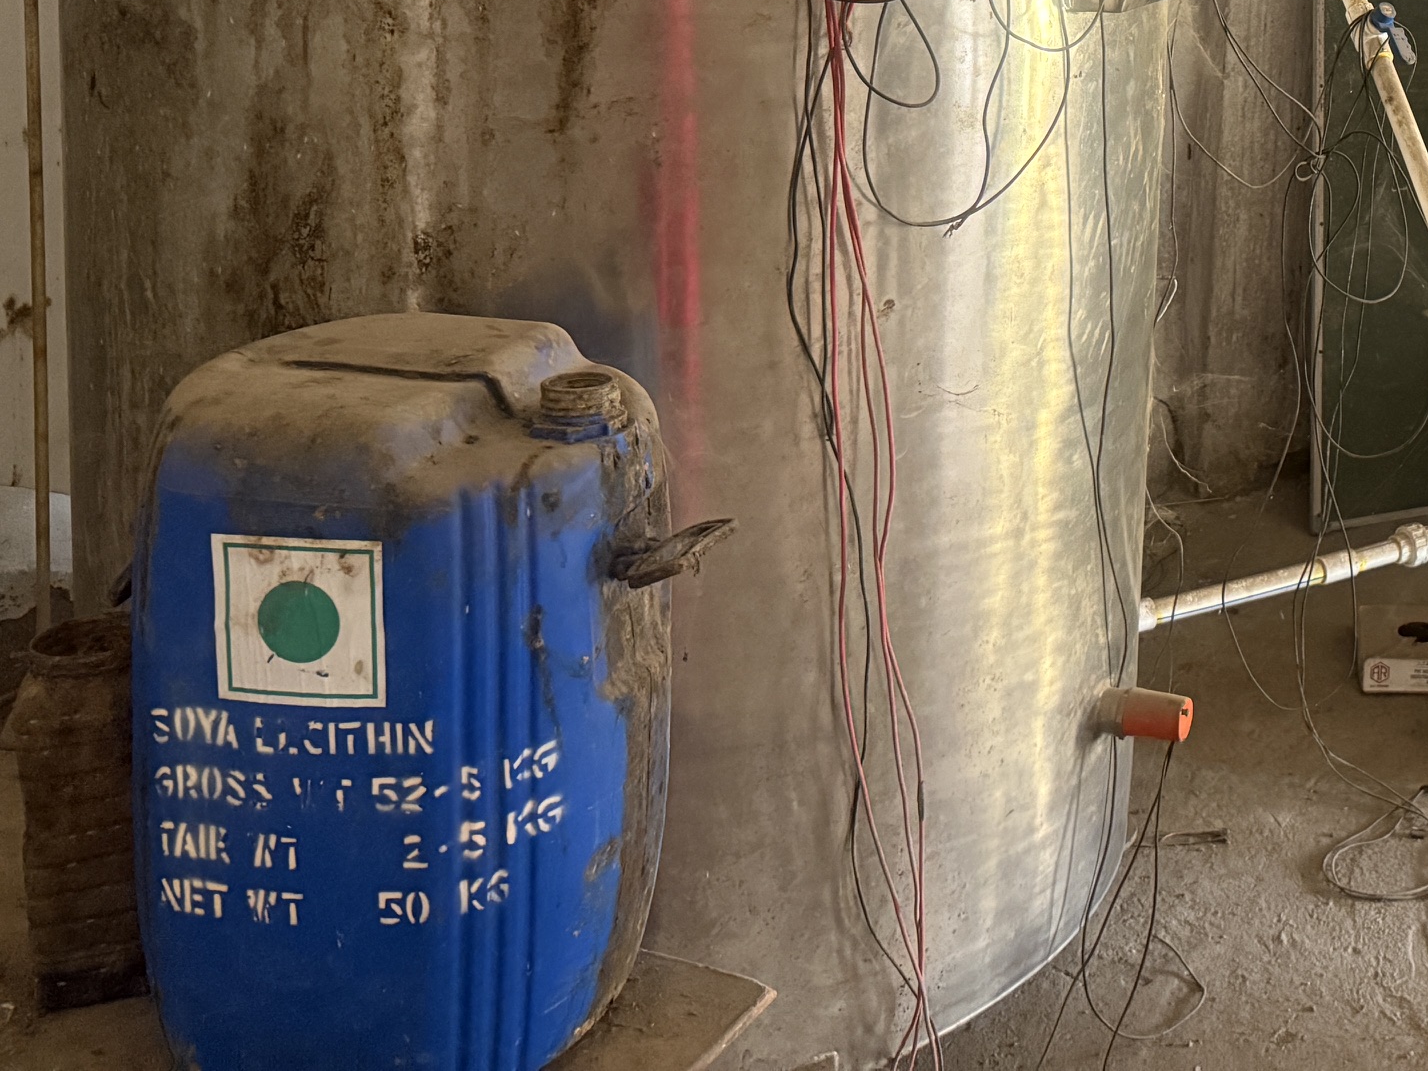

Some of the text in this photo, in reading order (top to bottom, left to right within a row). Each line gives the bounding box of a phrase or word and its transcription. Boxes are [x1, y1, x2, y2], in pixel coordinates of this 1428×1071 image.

[151, 707, 239, 749] SOYA
[155, 765, 273, 811] GROSS
[503, 740, 559, 790] KG
[160, 820, 231, 864] TAIR
[506, 794, 564, 845] KG
[161, 869, 510, 926] NET WT 50 KG
